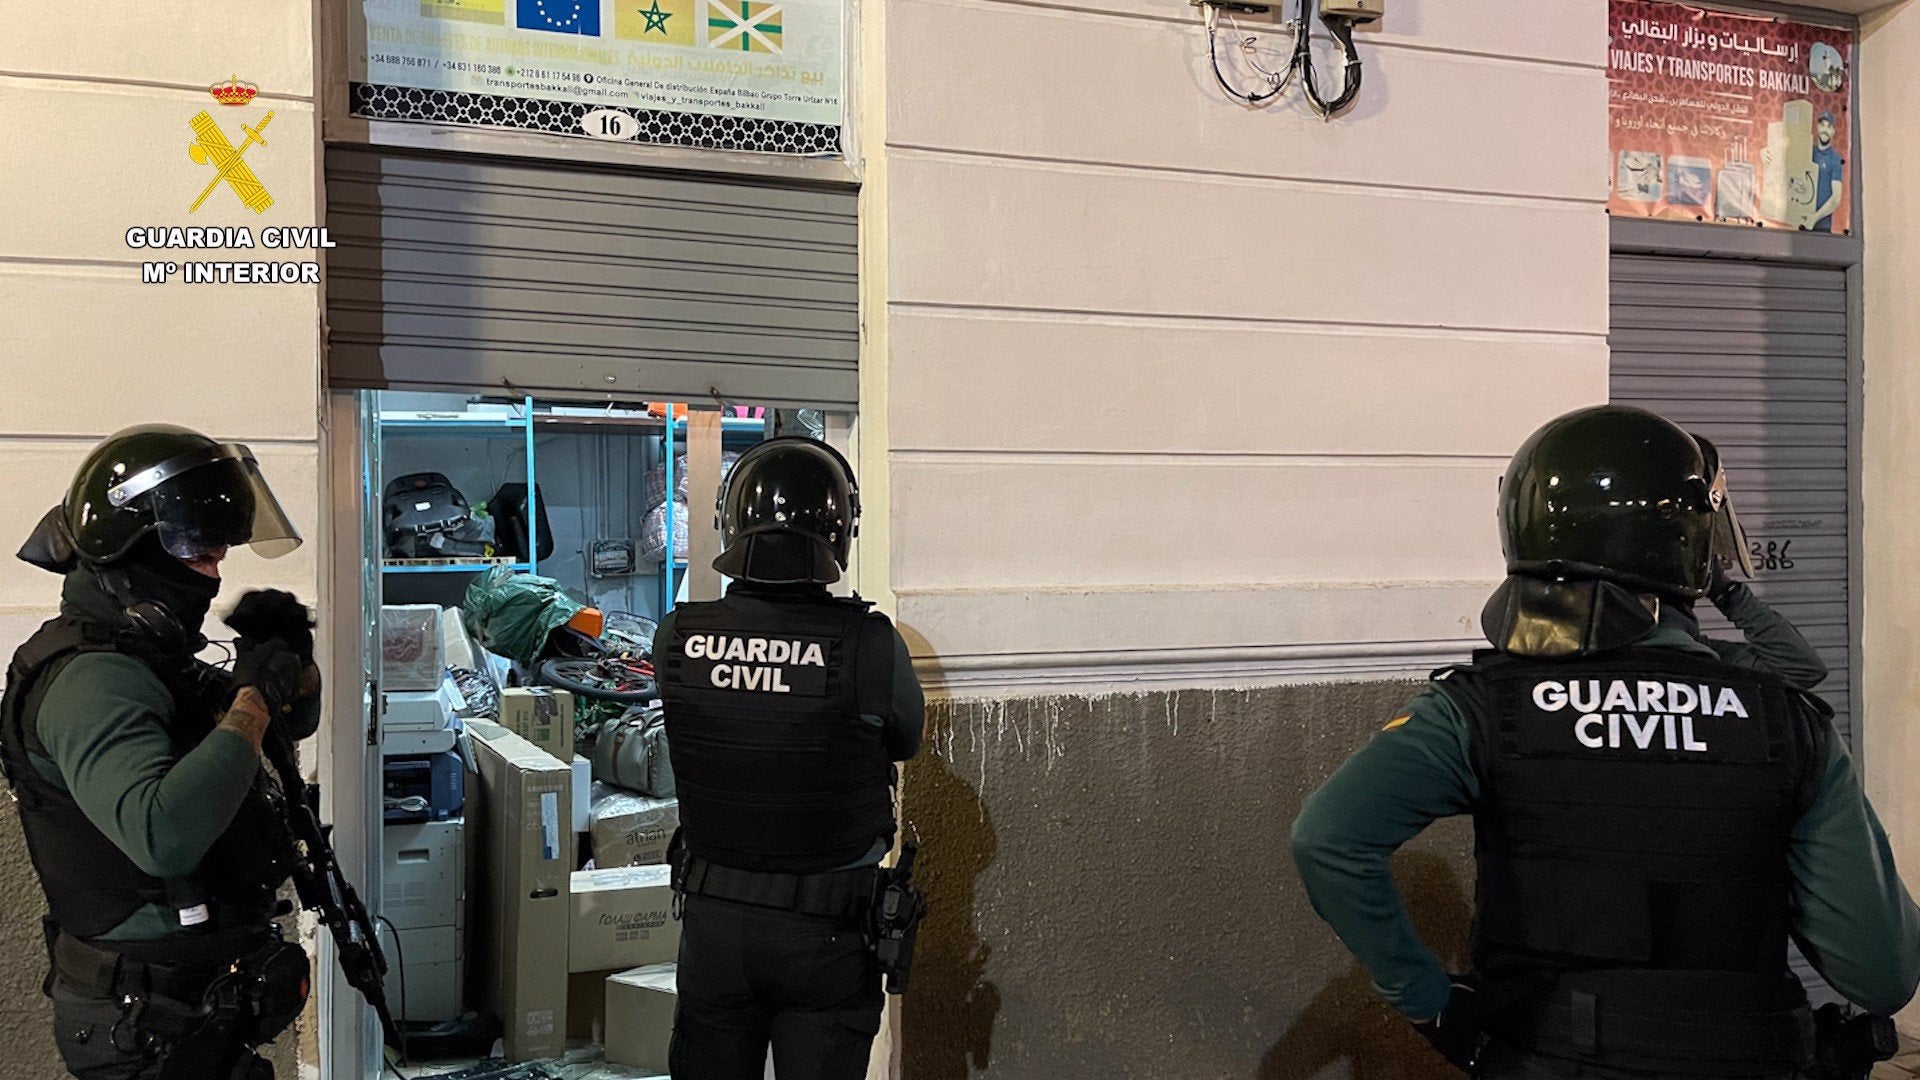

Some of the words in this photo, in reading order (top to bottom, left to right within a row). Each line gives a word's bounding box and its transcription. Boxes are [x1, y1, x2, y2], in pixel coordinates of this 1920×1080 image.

[1621, 19, 1678, 43] البقالي
[596, 76, 622, 85] Oficina
[624, 78, 653, 88] General
[1611, 49, 1654, 73] VIAJES
[1656, 55, 1665, 75] Y
[1667, 56, 1755, 88] TRANSPORTES
[1758, 69, 1810, 95] BAKKALI
[600, 114, 621, 136] 16
[684, 634, 826, 667] GUARDIA
[710, 663, 791, 693] CIVIL
[1532, 680, 1749, 718] GUARDIA
[1574, 713, 1707, 751] CIVIL
